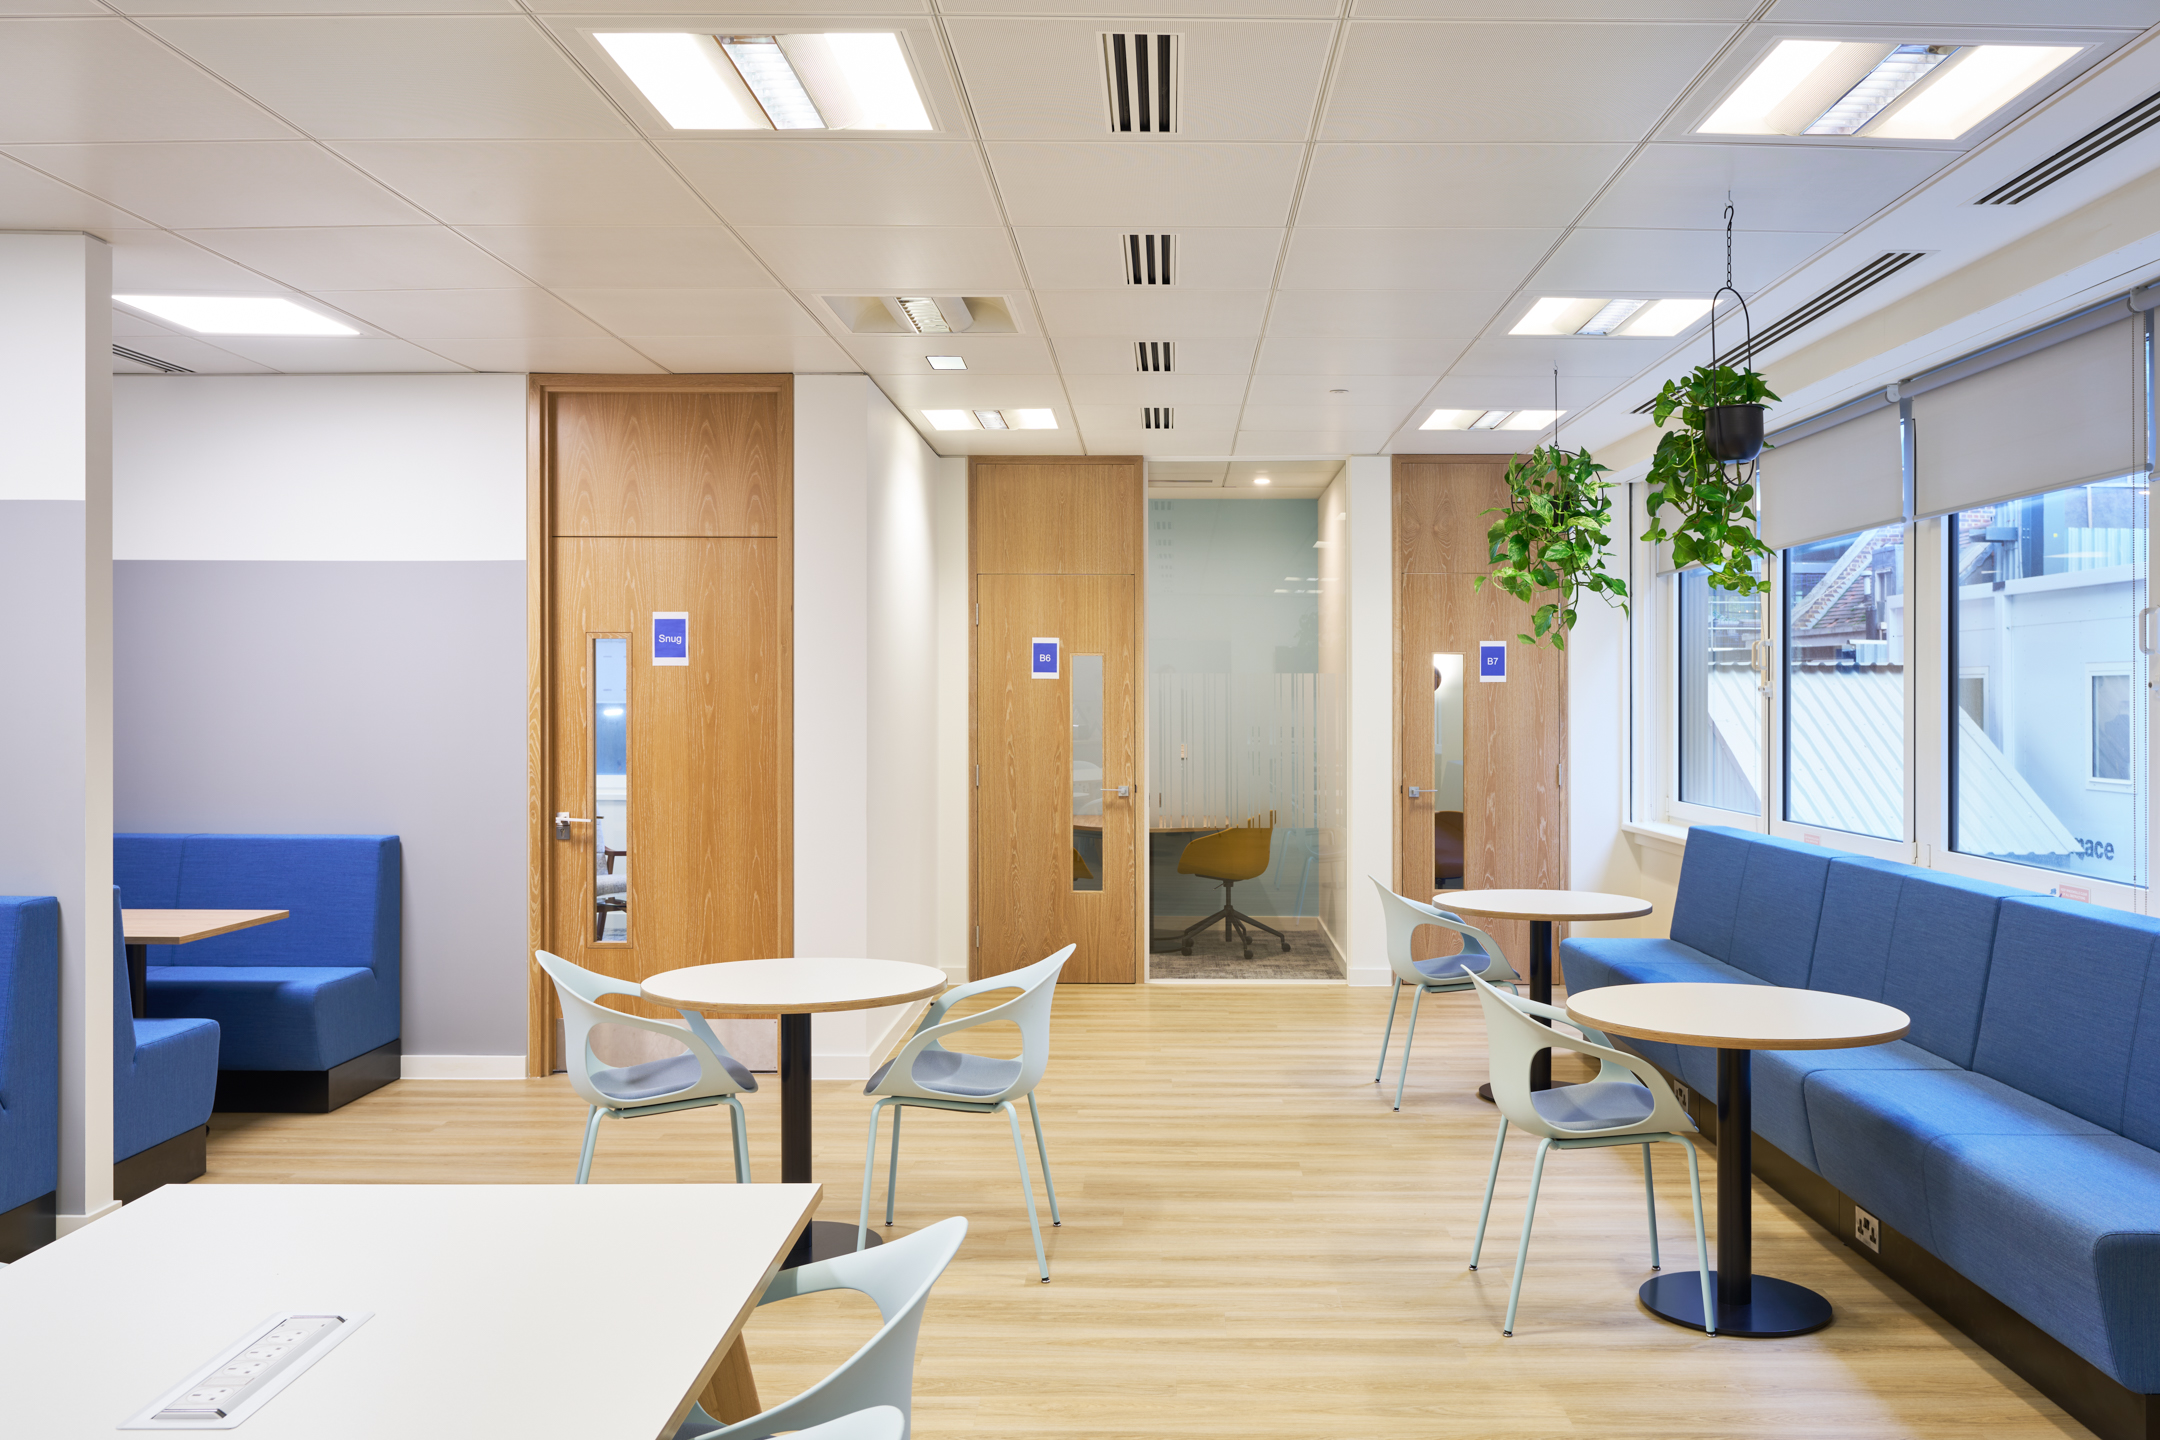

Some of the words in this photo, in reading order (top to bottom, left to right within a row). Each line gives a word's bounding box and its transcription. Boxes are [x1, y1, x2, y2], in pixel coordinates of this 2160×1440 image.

[658, 633, 682, 645] Snug
[1039, 653, 1051, 662] B6
[1487, 657, 1499, 666] B7
